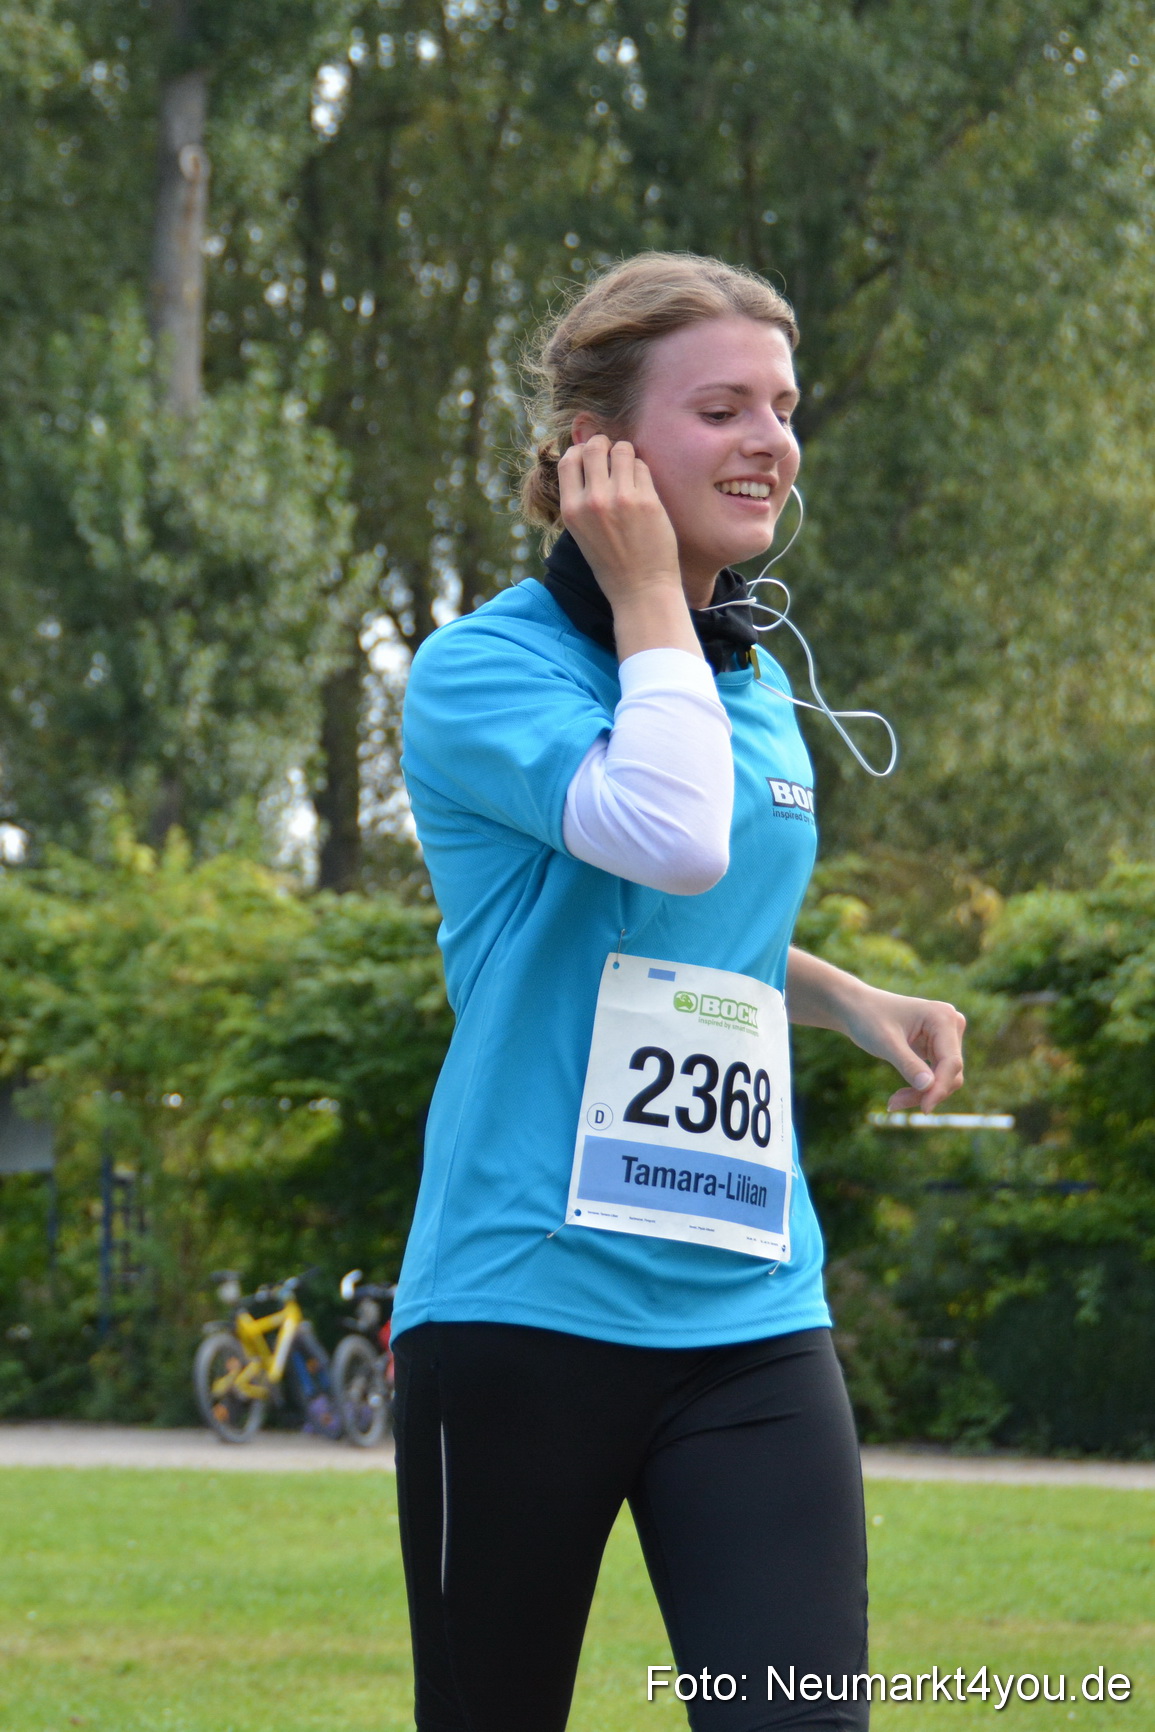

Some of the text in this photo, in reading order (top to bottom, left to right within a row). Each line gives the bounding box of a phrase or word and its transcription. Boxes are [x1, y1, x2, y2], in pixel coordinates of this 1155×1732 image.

[698, 1016, 723, 1029] inspired
[723, 1021, 731, 1030] by
[699, 994, 758, 1029] BOCK
[623, 1046, 771, 1148] 2368
[594, 1109, 605, 1124] D
[621, 1155, 768, 1208] Tamara-Lilian
